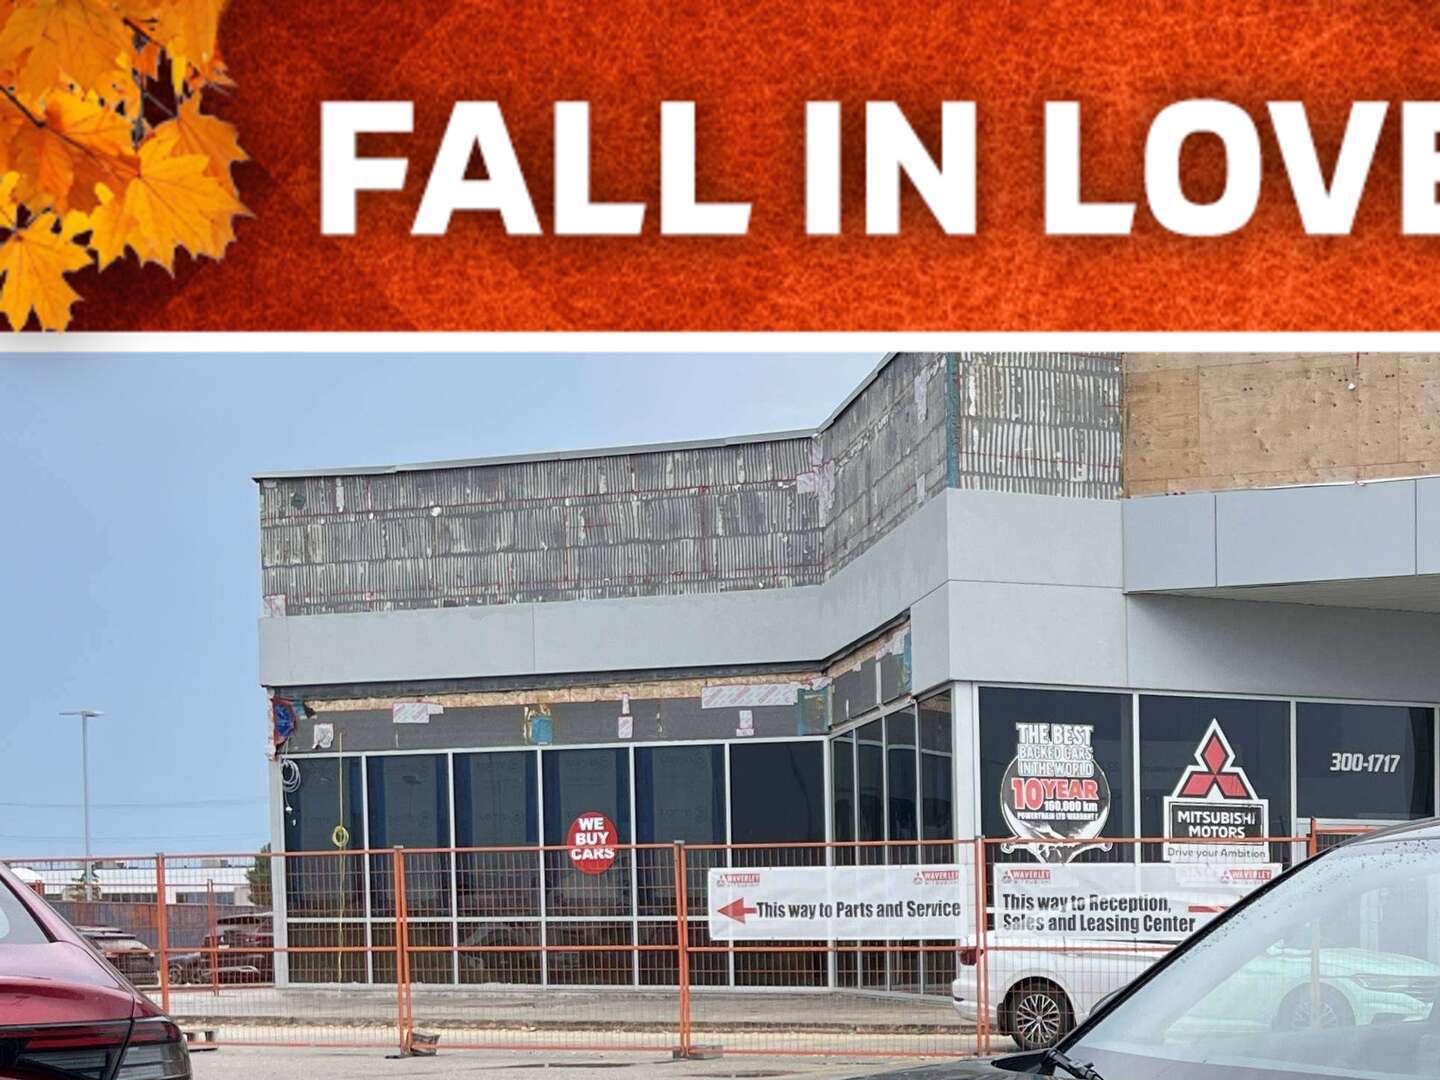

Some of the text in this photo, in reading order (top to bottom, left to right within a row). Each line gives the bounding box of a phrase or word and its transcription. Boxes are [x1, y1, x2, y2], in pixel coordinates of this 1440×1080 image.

[1016, 722, 1094, 746] THE BEST
[1018, 744, 1094, 761] BACKED CARS
[1018, 761, 1094, 778] IN THE WORLD
[1329, 752, 1401, 773] 300-1717
[1011, 777, 1099, 810] 10 YEAR
[1083, 801, 1098, 812] km
[577, 817, 605, 831] WE
[1177, 810, 1256, 825] MITSUBISHI
[575, 832, 610, 846] BUY
[1188, 825, 1246, 839] MOTORS
[571, 847, 615, 860] CARS
[1167, 847, 1266, 860] Drive your Ambition
[756, 899, 961, 920] This way to Parts and Service
[1003, 894, 1172, 914] This way to Reception,
[1003, 913, 1196, 934] Sales and Leasing Center
